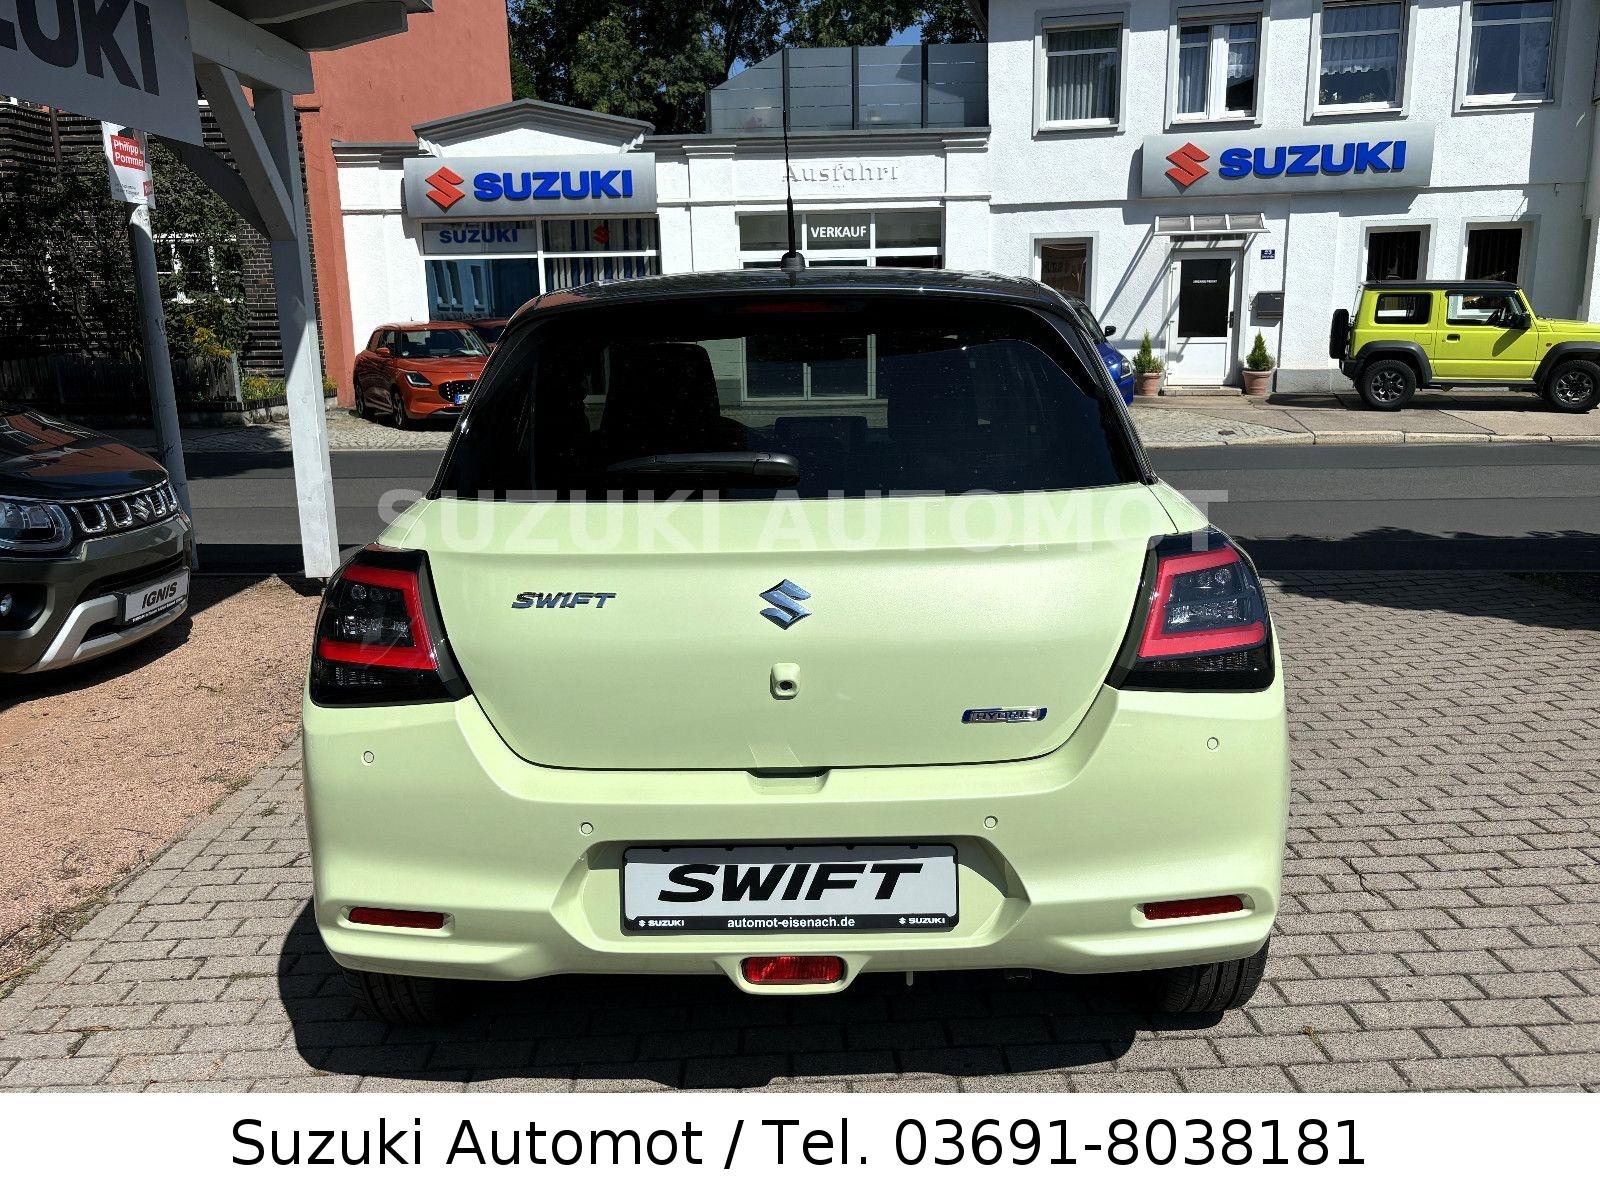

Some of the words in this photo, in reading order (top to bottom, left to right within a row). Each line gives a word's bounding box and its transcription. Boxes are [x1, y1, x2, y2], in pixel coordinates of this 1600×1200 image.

[0, 0, 160, 96] UKI
[113, 139, 139, 156] Philipp
[1221, 140, 1407, 174] SUZUKI
[782, 162, 899, 182] Ausfahrt
[474, 169, 633, 200] SUZUKI
[439, 228, 518, 244] SUZUKI
[810, 225, 868, 238] VERKAUF
[141, 581, 178, 610] IGNIS
[511, 591, 617, 610] SWIFT
[657, 862, 924, 903] SWIFT
[648, 918, 685, 927] SUZUKI
[727, 916, 855, 929] automot-eisenach.de
[908, 916, 946, 925] SUZUKI
